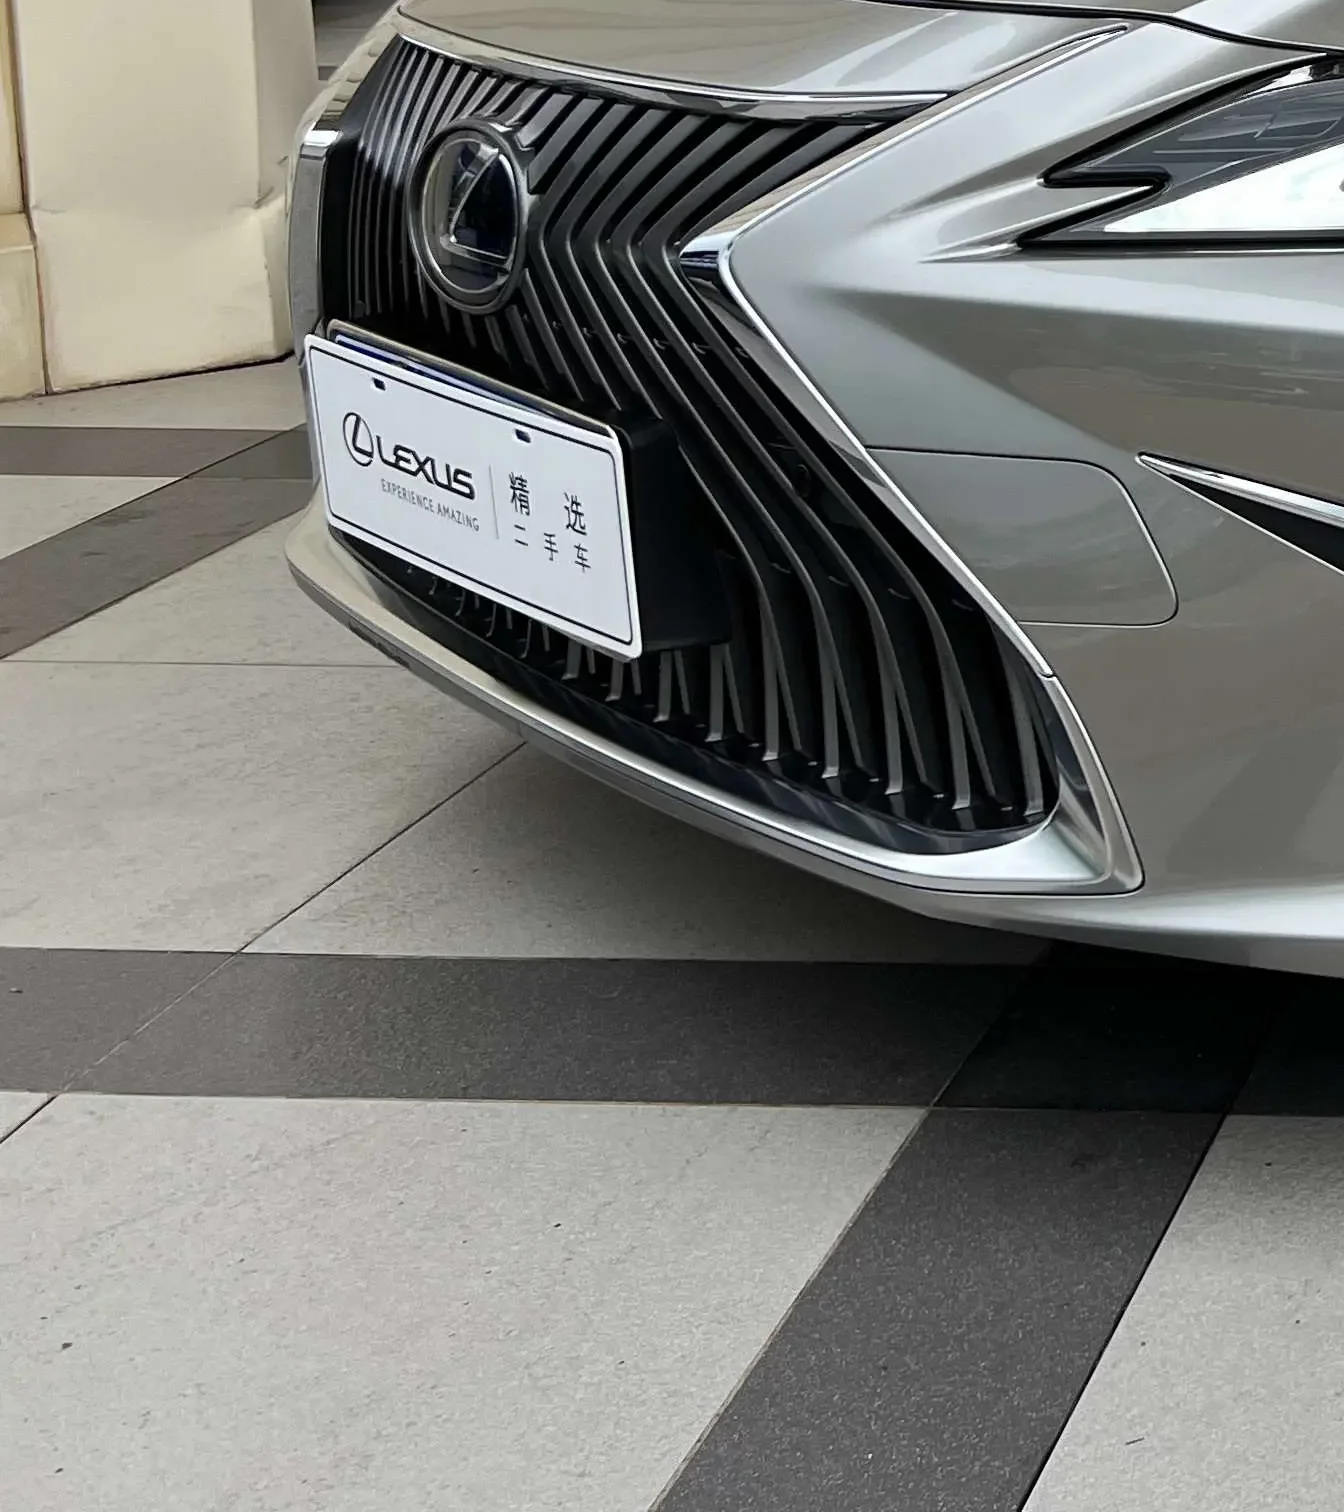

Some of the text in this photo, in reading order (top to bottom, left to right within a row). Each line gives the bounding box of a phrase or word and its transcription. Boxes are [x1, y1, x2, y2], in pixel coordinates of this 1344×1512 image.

[375, 434, 475, 500] LEXUS
[381, 477, 480, 533] EXPERIENCE AMAZING
[513, 523, 592, 573] 二手车
